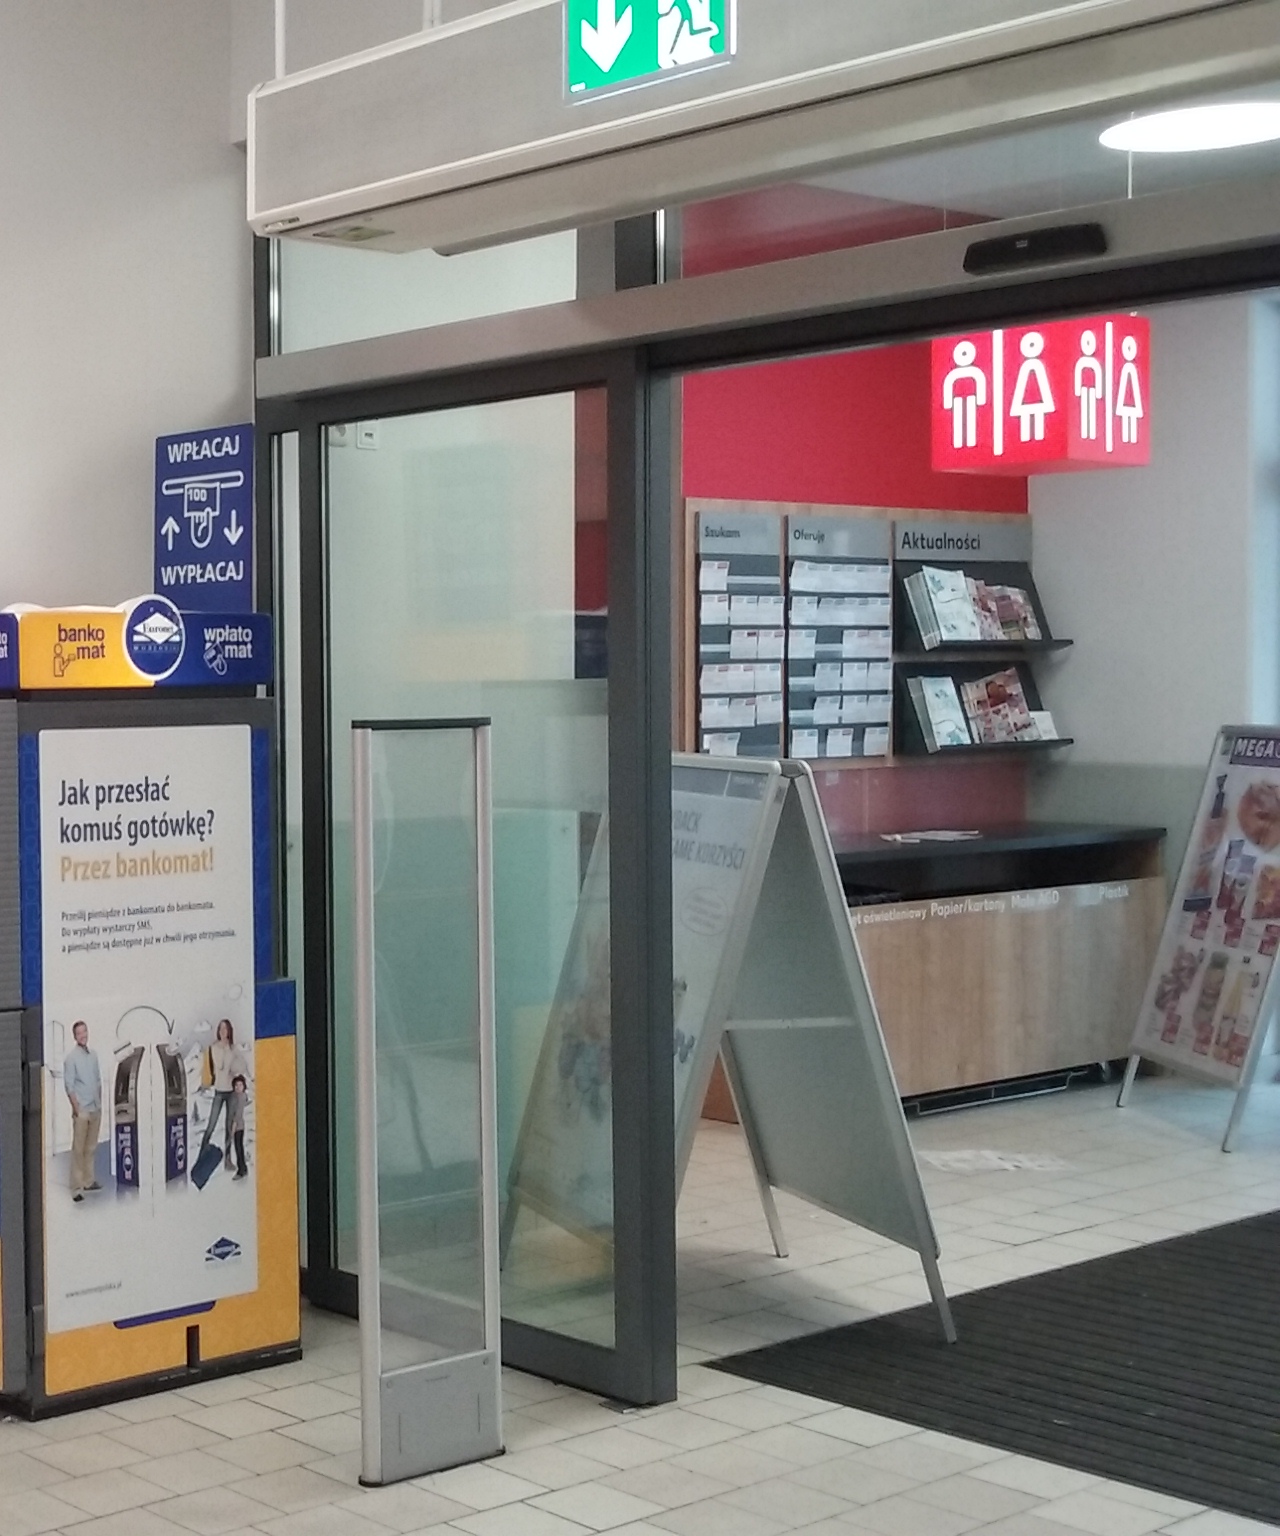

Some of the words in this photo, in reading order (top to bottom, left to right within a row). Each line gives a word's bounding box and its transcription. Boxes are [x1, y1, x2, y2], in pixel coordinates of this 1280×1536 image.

[168, 434, 240, 464] WPŁACAJ
[187, 488, 208, 502] 100
[704, 525, 741, 539] Szukam
[901, 531, 981, 550] Aktualności
[161, 559, 244, 586] WYPŁACAJ
[58, 622, 106, 642] banko
[142, 622, 174, 634] Euronet
[203, 624, 253, 643] wpłato
[76, 641, 106, 660] mat
[224, 642, 253, 659] mat
[58, 778, 91, 807] Jak
[95, 775, 170, 811] przesłać
[60, 814, 123, 844] komuś
[127, 809, 215, 846] gotówkę?
[61, 855, 112, 882] Przez
[116, 846, 215, 879] bankomat!
